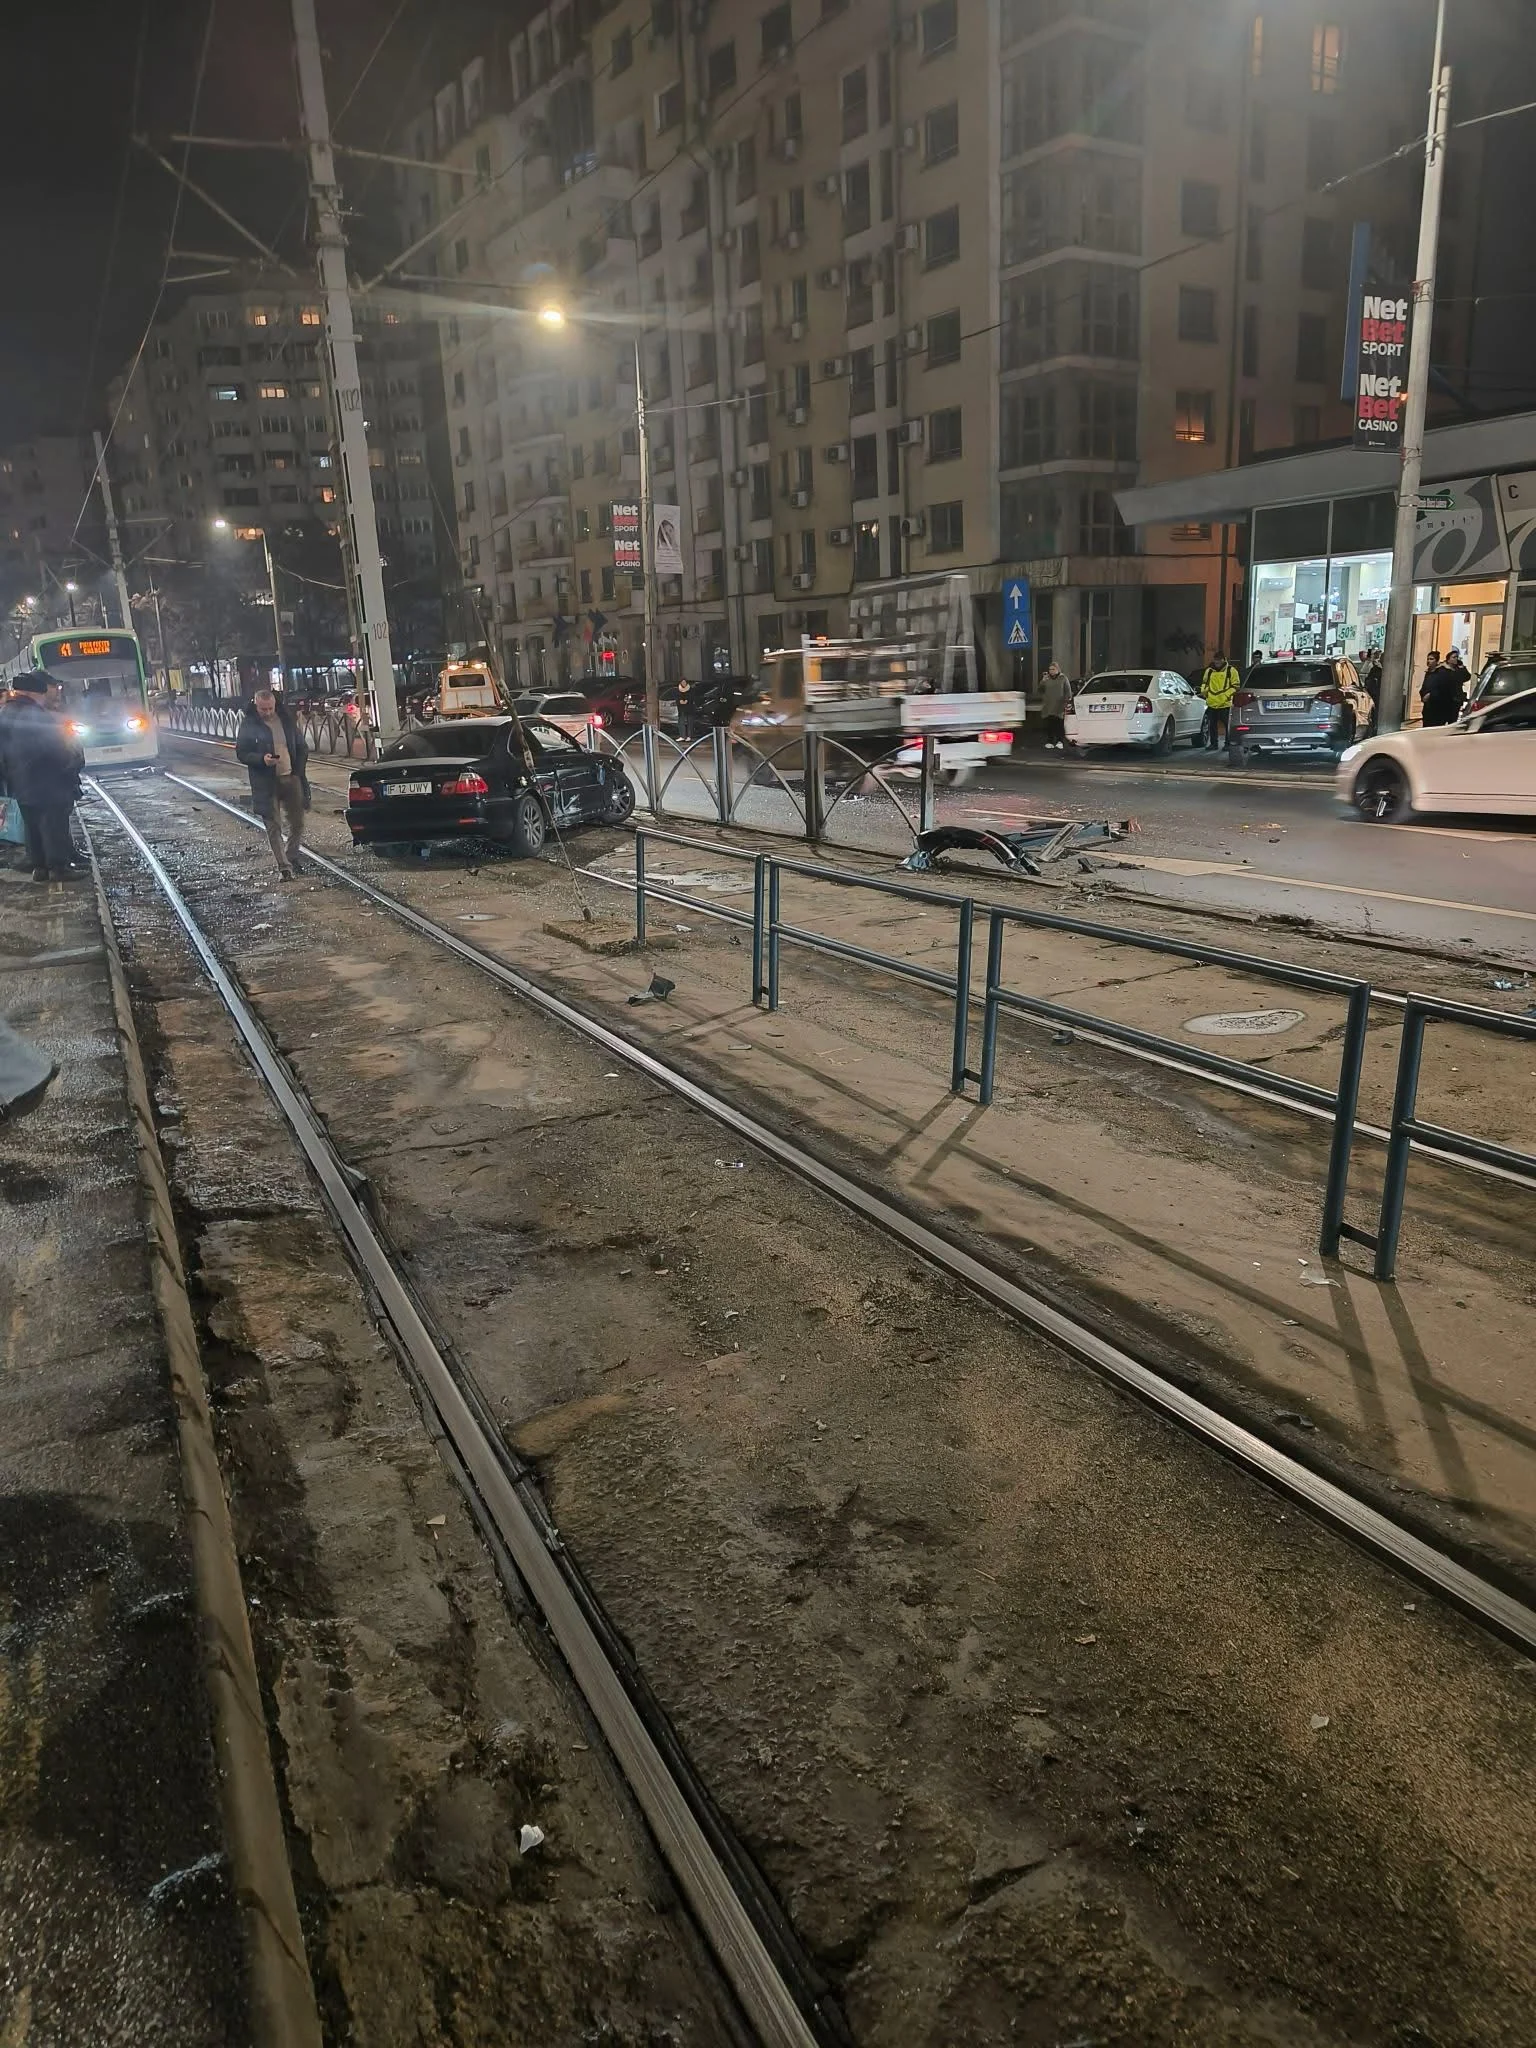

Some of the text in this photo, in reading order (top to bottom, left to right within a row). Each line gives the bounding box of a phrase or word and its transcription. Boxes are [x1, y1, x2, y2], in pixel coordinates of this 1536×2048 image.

[1364, 295, 1408, 321] Net
[1362, 318, 1406, 343] Bet
[1362, 342, 1404, 357] SPORT
[1360, 374, 1401, 397] Net
[1358, 396, 1399, 420] Bet
[1358, 419, 1398, 432] CASINO
[1508, 484, 1519, 499] C
[613, 504, 638, 515] Net
[614, 540, 640, 551] Net
[372, 622, 388, 641] 102
[399, 784, 407, 794] 12
[410, 782, 429, 793] UWY
